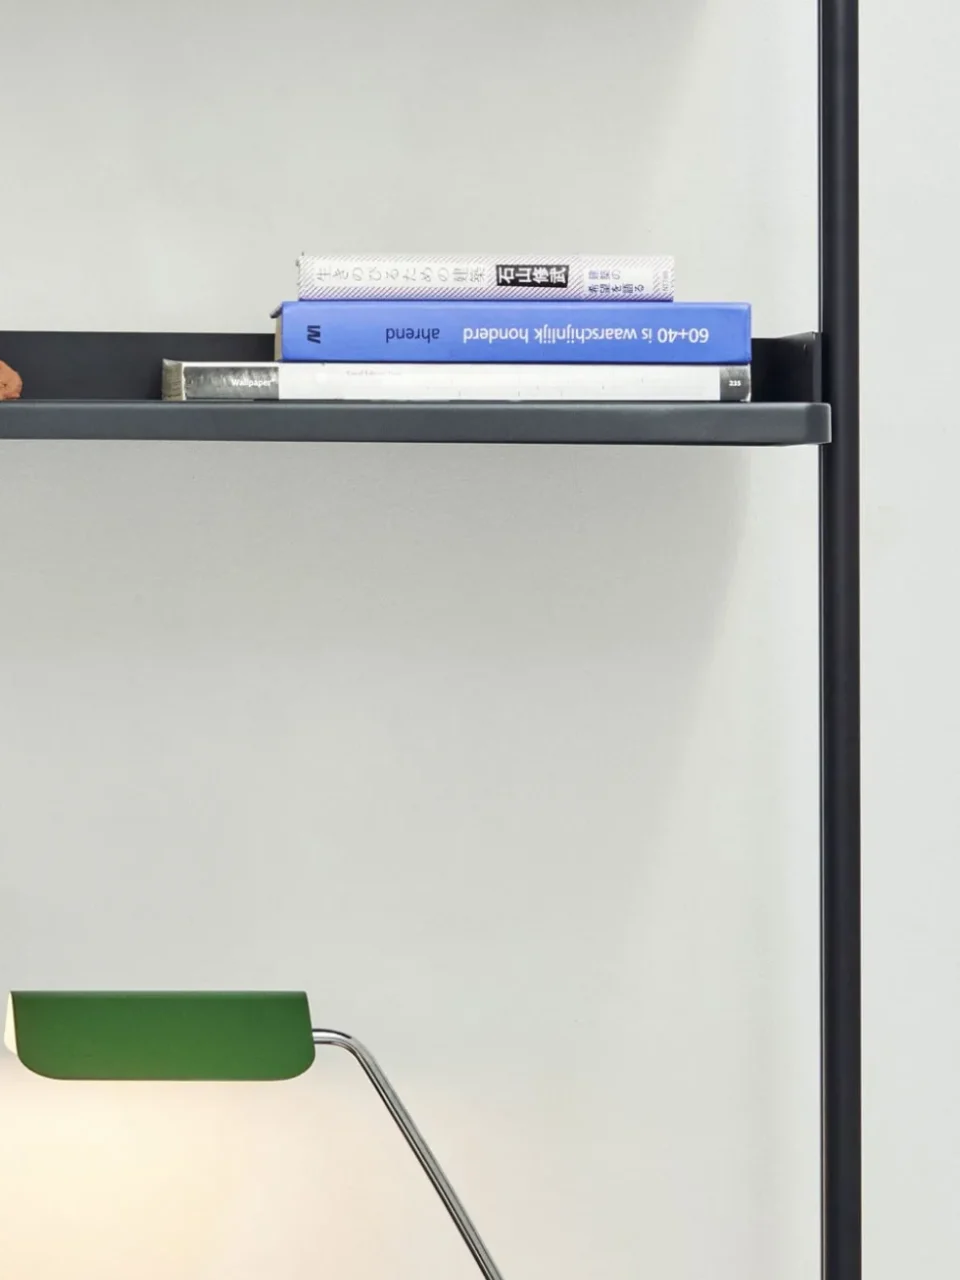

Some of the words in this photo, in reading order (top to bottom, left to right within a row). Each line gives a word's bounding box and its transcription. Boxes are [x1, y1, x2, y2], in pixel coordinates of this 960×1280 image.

[497, 265, 568, 285] 石山修武
[385, 327, 441, 344] ahrend
[462, 327, 529, 344] honderd
[533, 323, 638, 344] waarschijnlijk
[641, 327, 653, 344] is
[656, 327, 710, 344] 60+40
